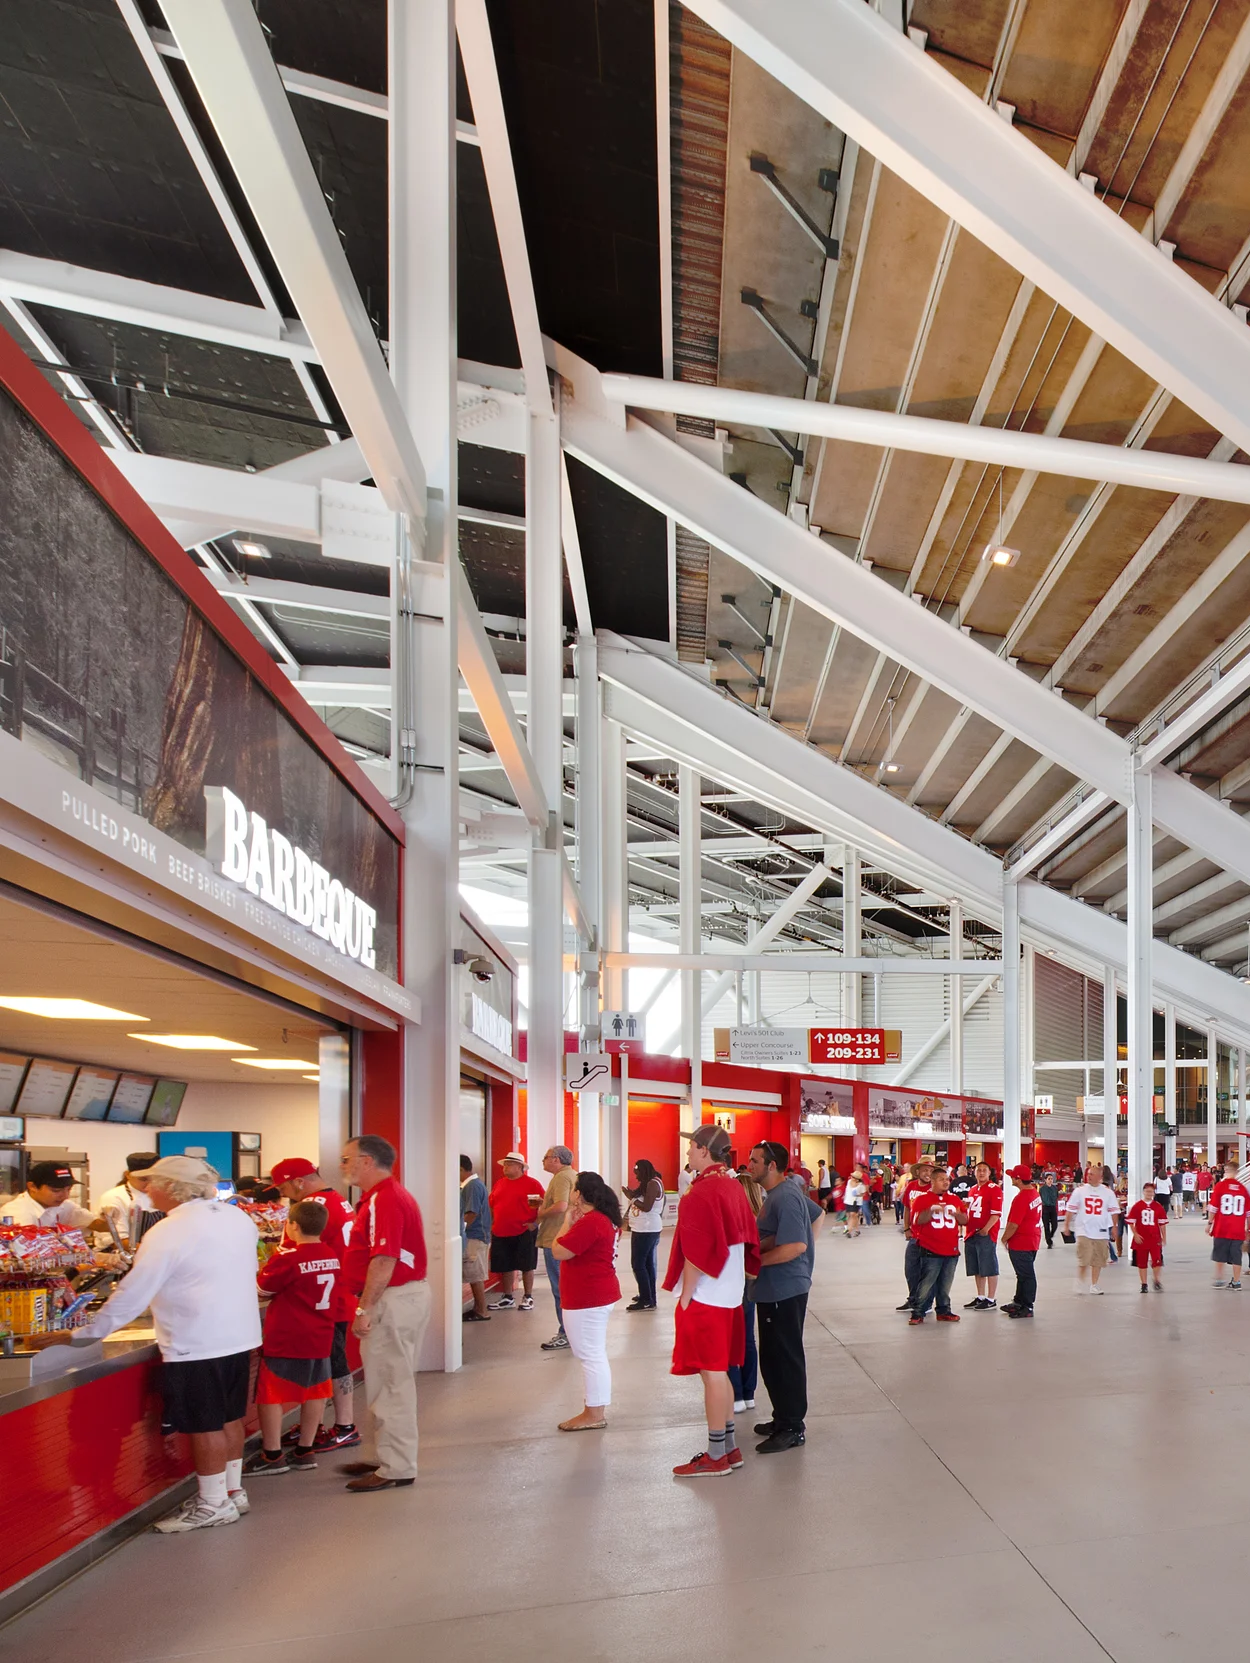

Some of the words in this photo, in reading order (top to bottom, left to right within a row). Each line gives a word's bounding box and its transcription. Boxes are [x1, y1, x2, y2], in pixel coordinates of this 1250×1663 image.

[62, 790, 119, 840] PULLED
[123, 826, 157, 864] PORK
[168, 854, 195, 885] BEEF
[198, 872, 237, 909] BRISKET
[222, 786, 377, 970] BARBEQUE
[826, 1032, 881, 1044] 109-134
[826, 1047, 881, 1059] 209-231
[1084, 1197, 1103, 1215] 52
[1220, 1193, 1246, 1216] 80
[1140, 1210, 1155, 1226] 81
[315, 1273, 335, 1310] 7
